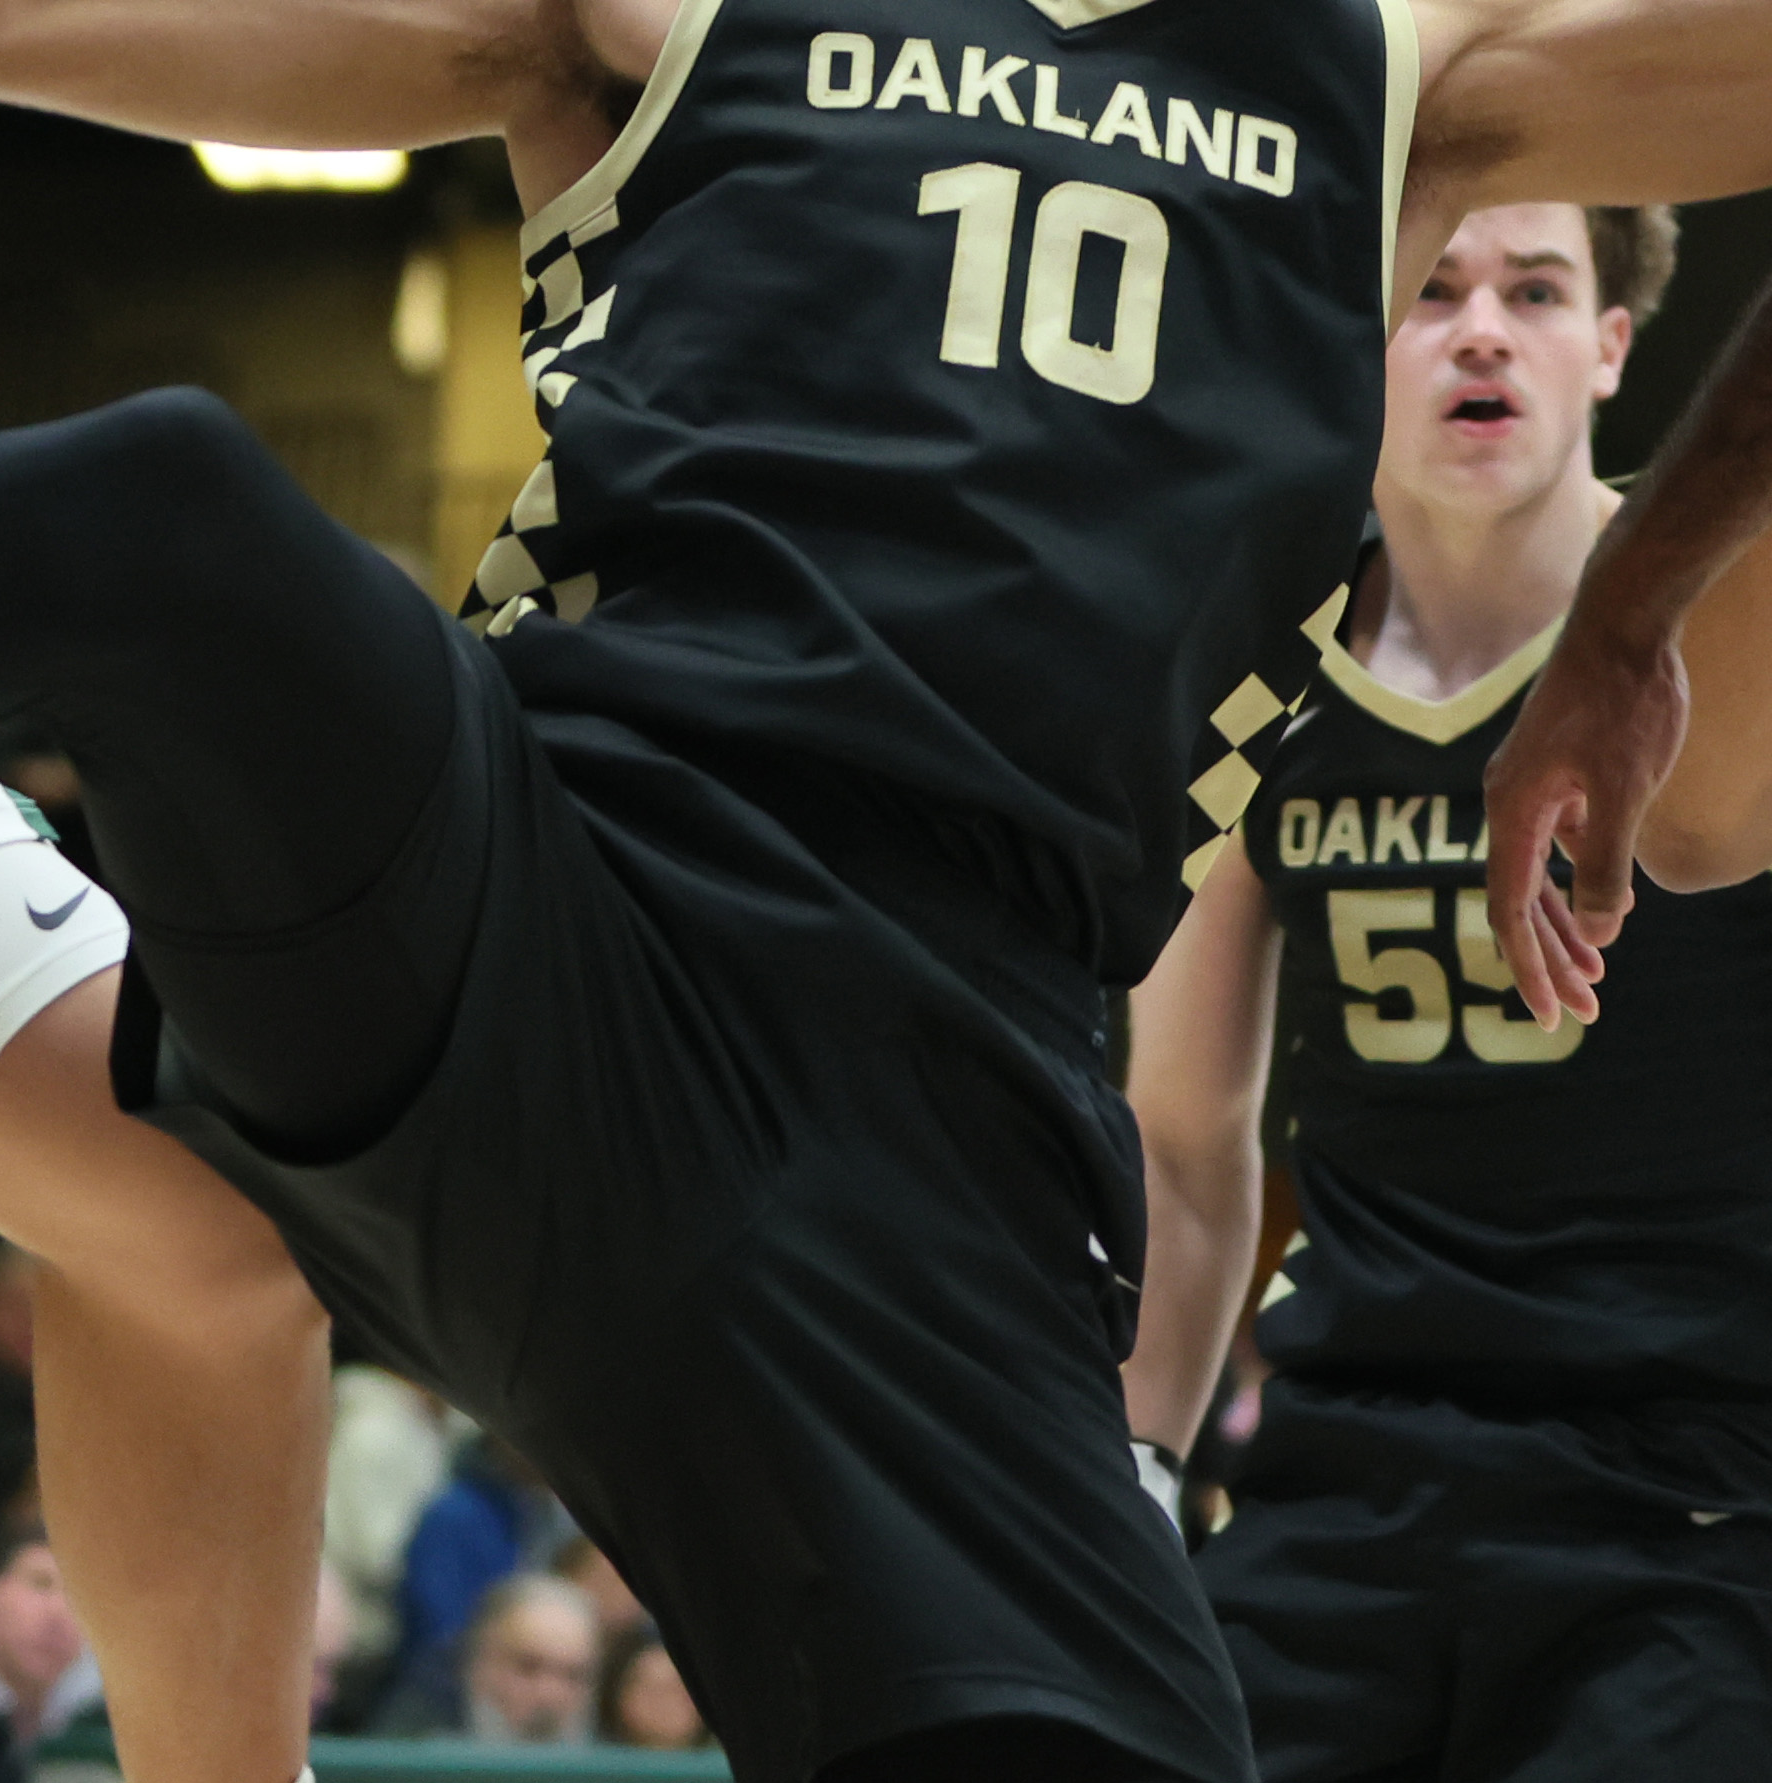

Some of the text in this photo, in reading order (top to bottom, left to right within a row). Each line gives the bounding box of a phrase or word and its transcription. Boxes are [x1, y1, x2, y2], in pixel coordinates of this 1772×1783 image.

[806, 31, 1297, 198] OAKLAND
[917, 161, 1169, 405] 10
[1279, 795, 1490, 868] OAKL
[1328, 887, 1585, 1063] 55
